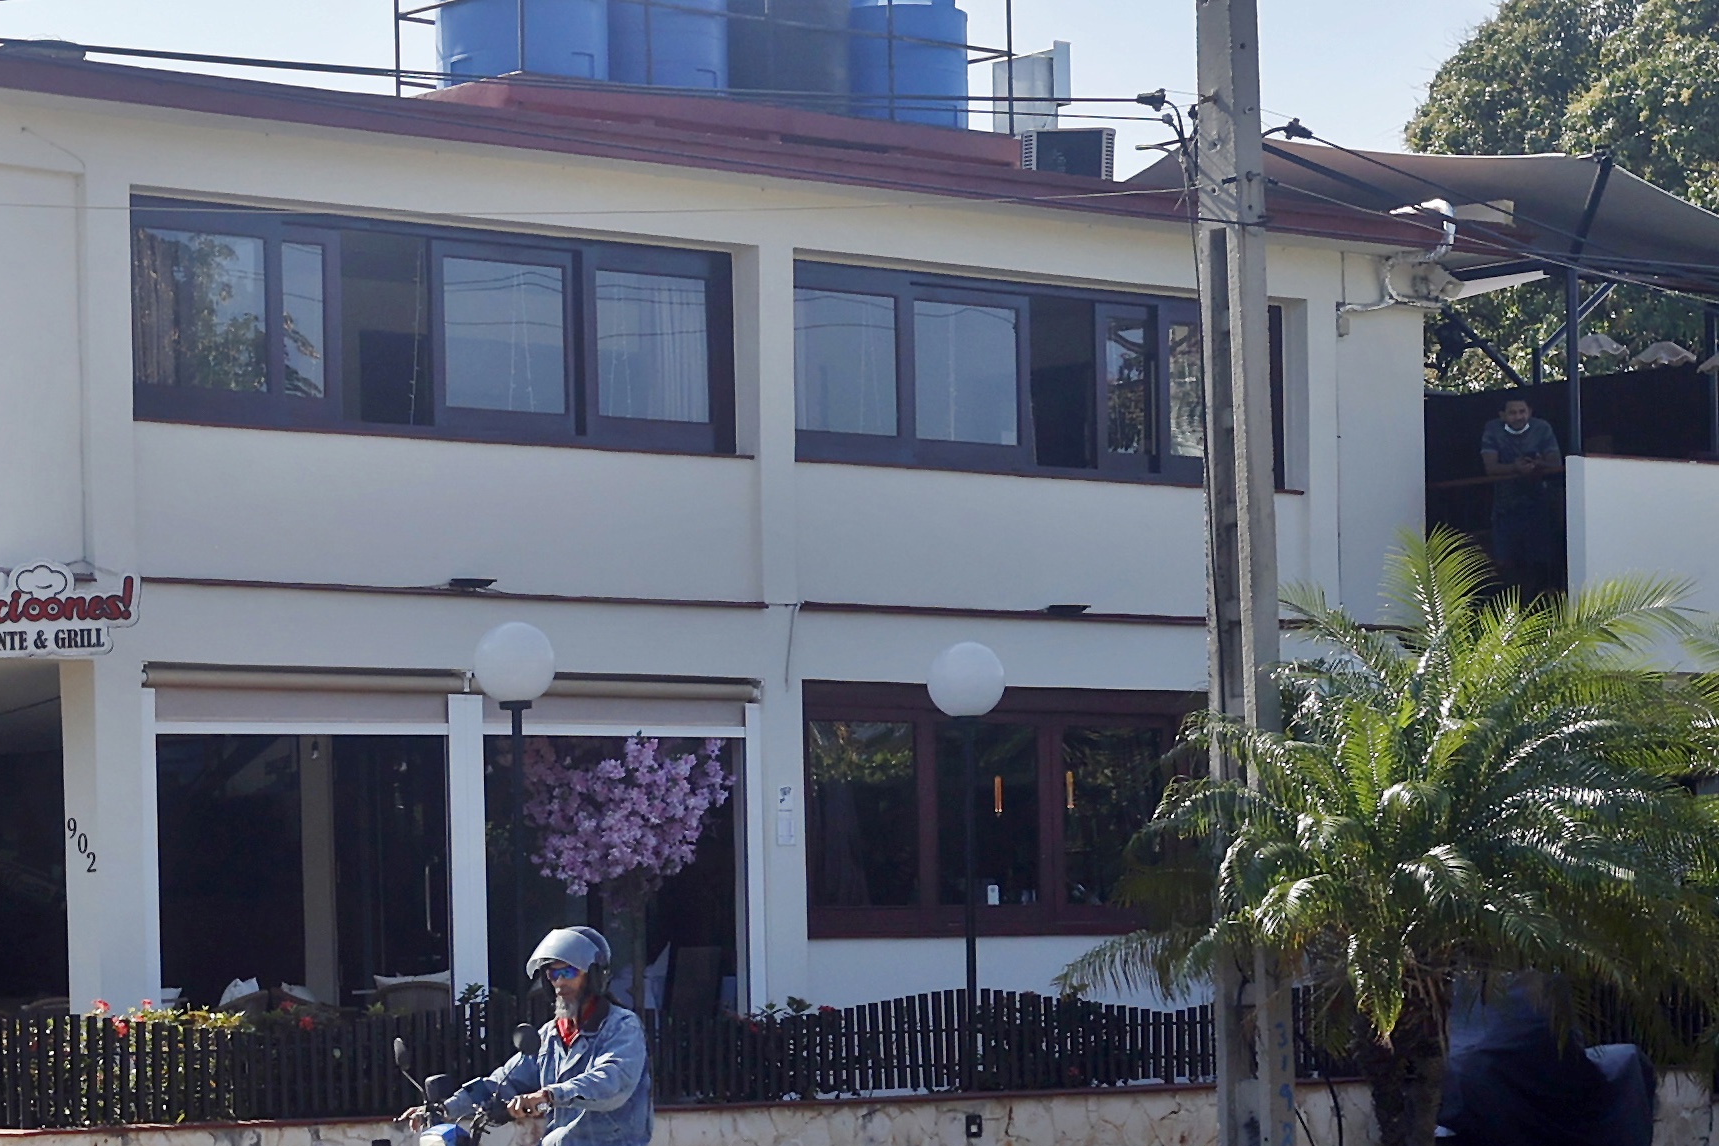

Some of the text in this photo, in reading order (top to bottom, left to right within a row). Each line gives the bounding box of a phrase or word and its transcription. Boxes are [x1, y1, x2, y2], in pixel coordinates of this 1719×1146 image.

[33, 629, 48, 650] &
[54, 627, 105, 650] GRILL
[67, 817, 97, 873] 902
